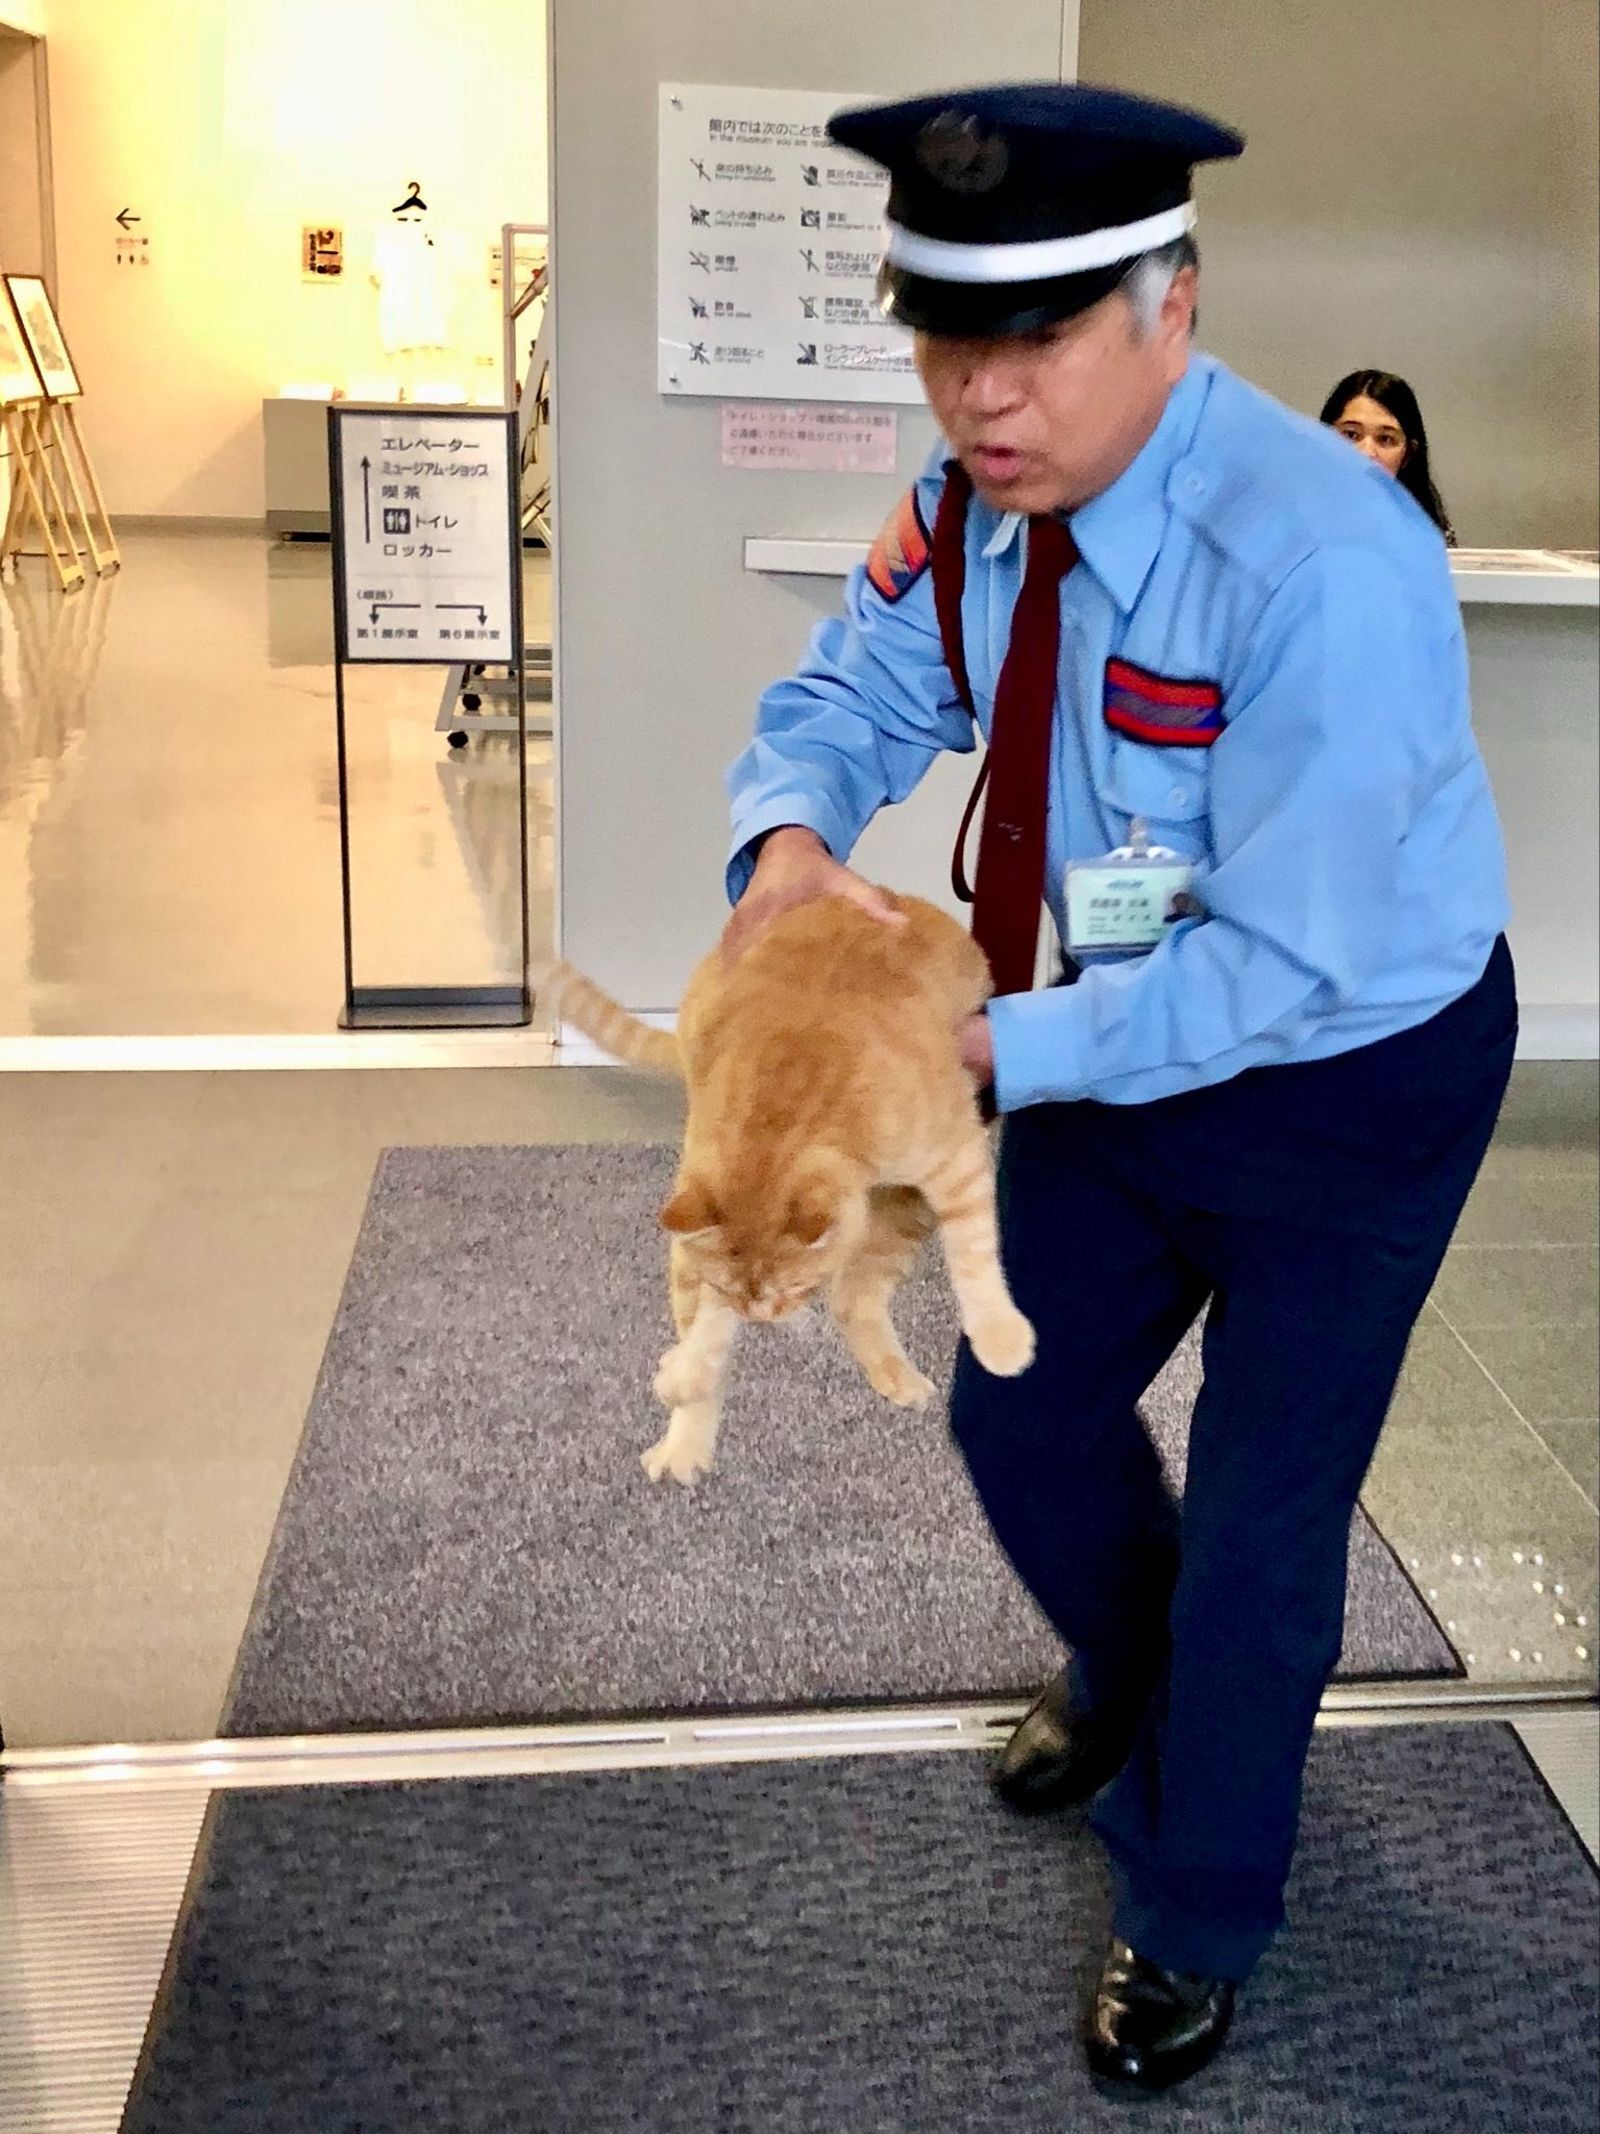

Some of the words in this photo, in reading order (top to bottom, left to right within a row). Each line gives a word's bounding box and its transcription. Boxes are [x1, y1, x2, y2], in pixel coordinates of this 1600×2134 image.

[381, 437, 480, 452] エレベーター
[415, 514, 458, 529] トイレ
[383, 543, 452, 558] ロッカー
